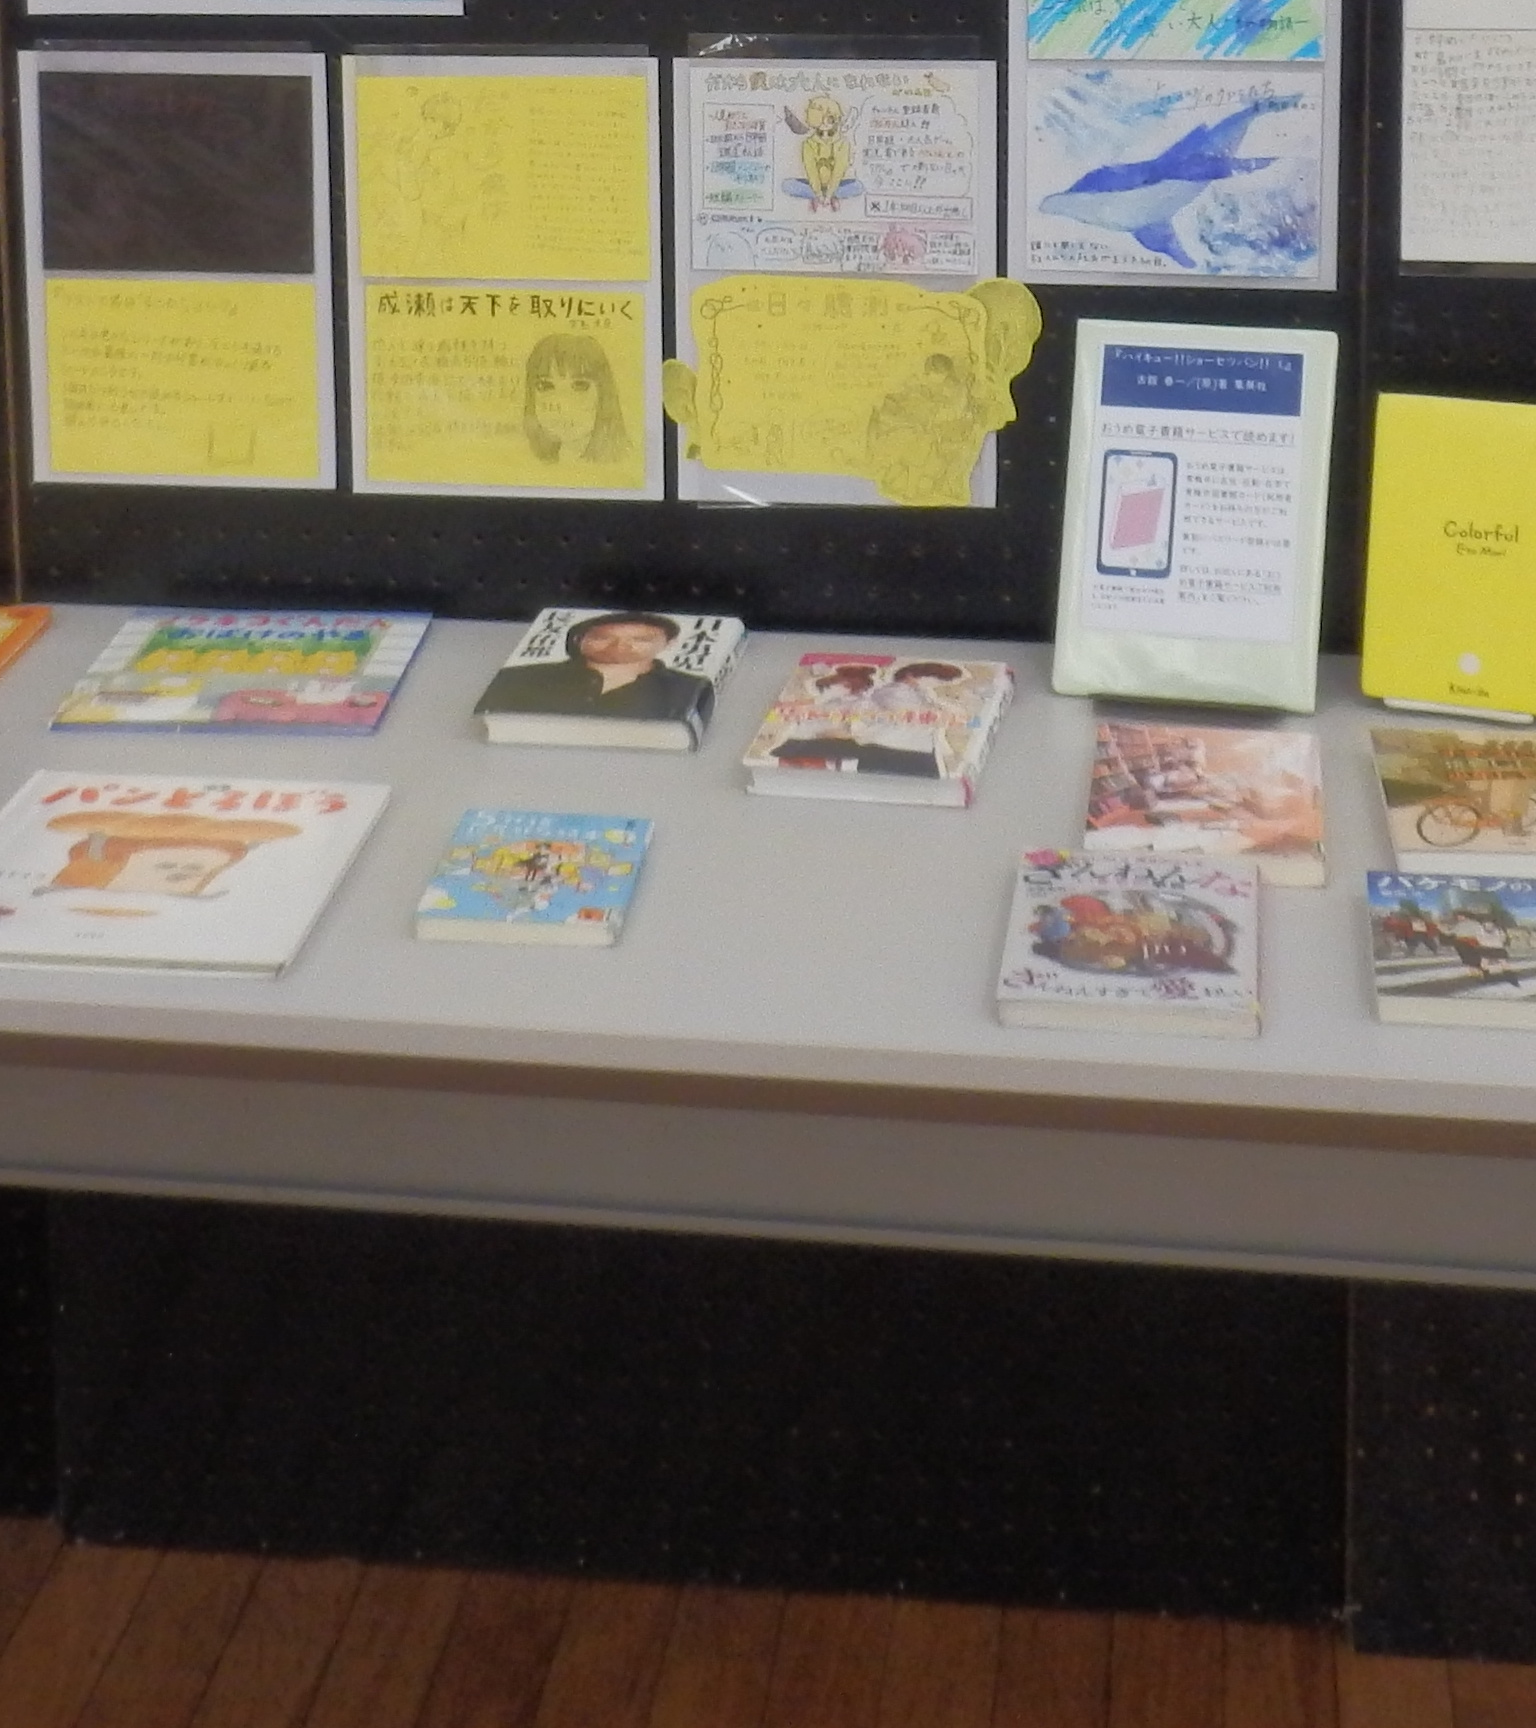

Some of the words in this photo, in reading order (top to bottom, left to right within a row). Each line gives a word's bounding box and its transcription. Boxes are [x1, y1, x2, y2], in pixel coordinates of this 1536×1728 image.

[377, 290, 634, 321] 成瀬は天下を取りにいく
[1443, 520, 1520, 544] Colorful
